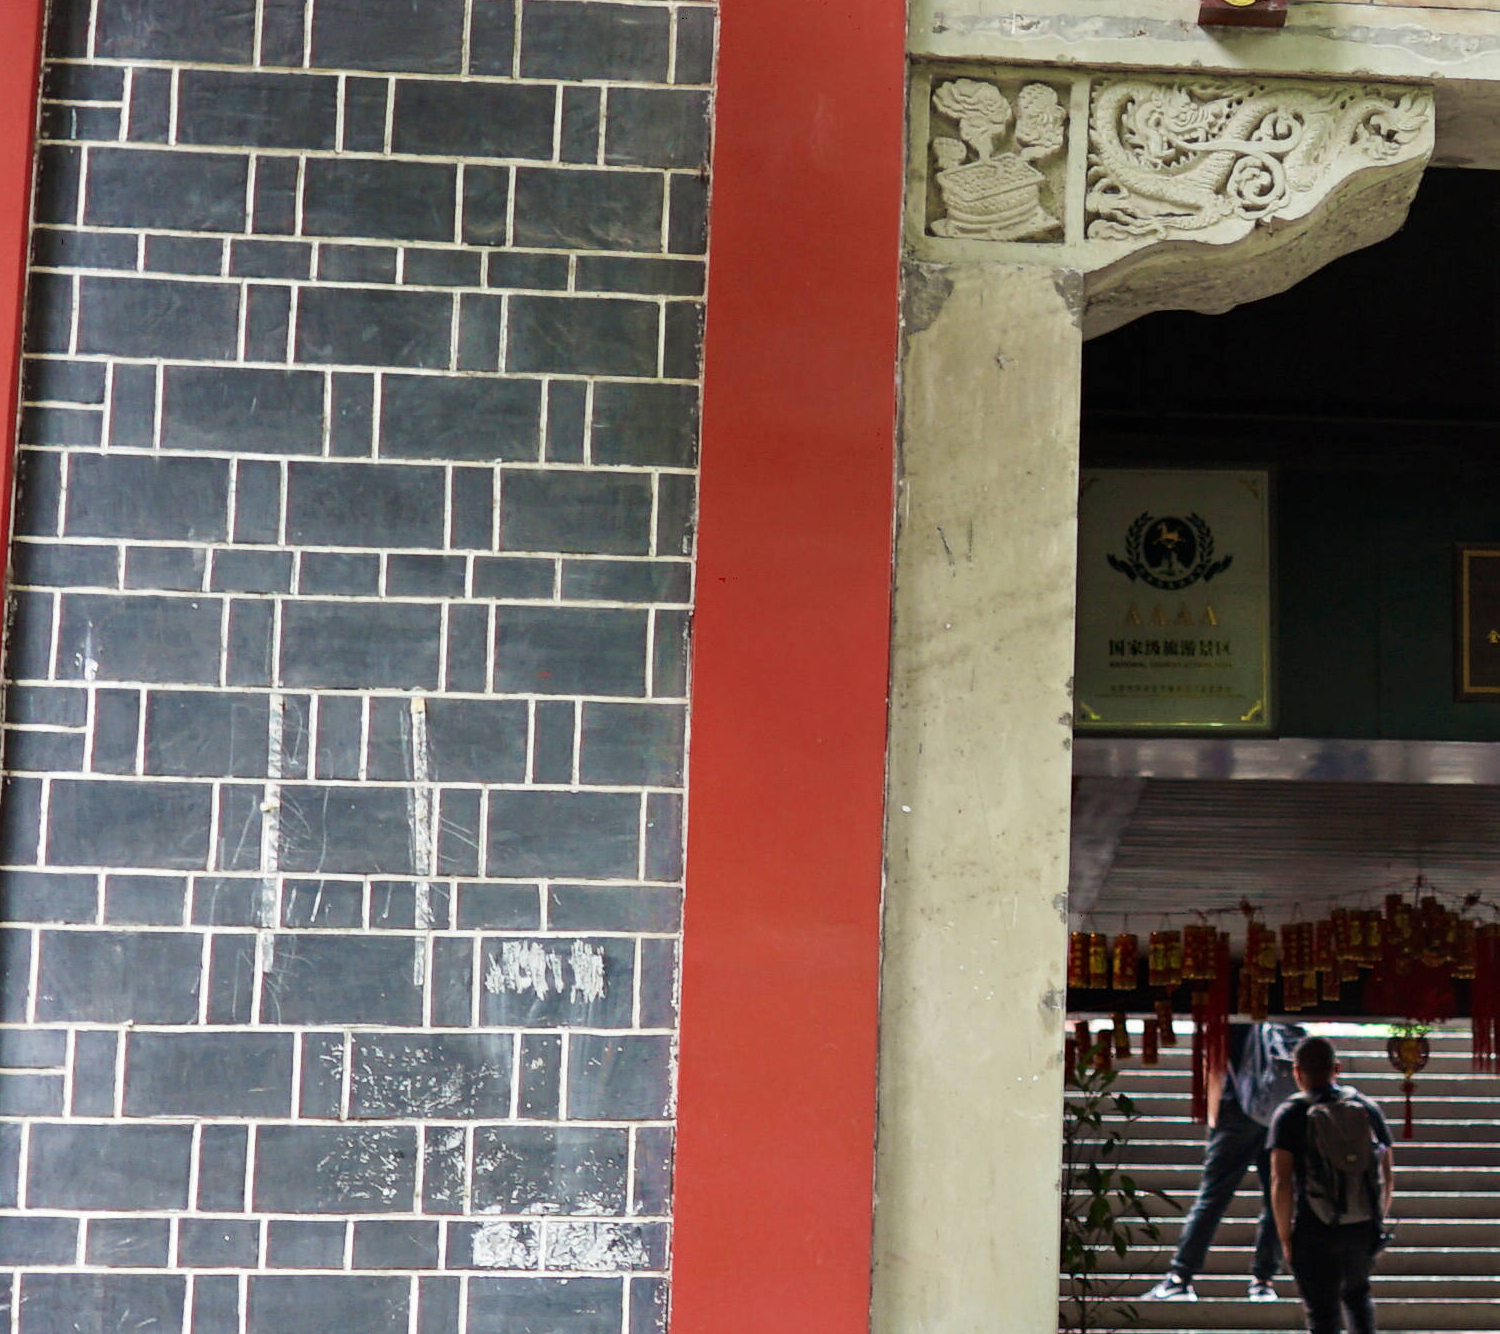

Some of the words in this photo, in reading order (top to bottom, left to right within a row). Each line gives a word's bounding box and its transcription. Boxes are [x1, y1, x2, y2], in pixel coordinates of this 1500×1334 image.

[1108, 639, 1232, 657] 国家级旅游景区
